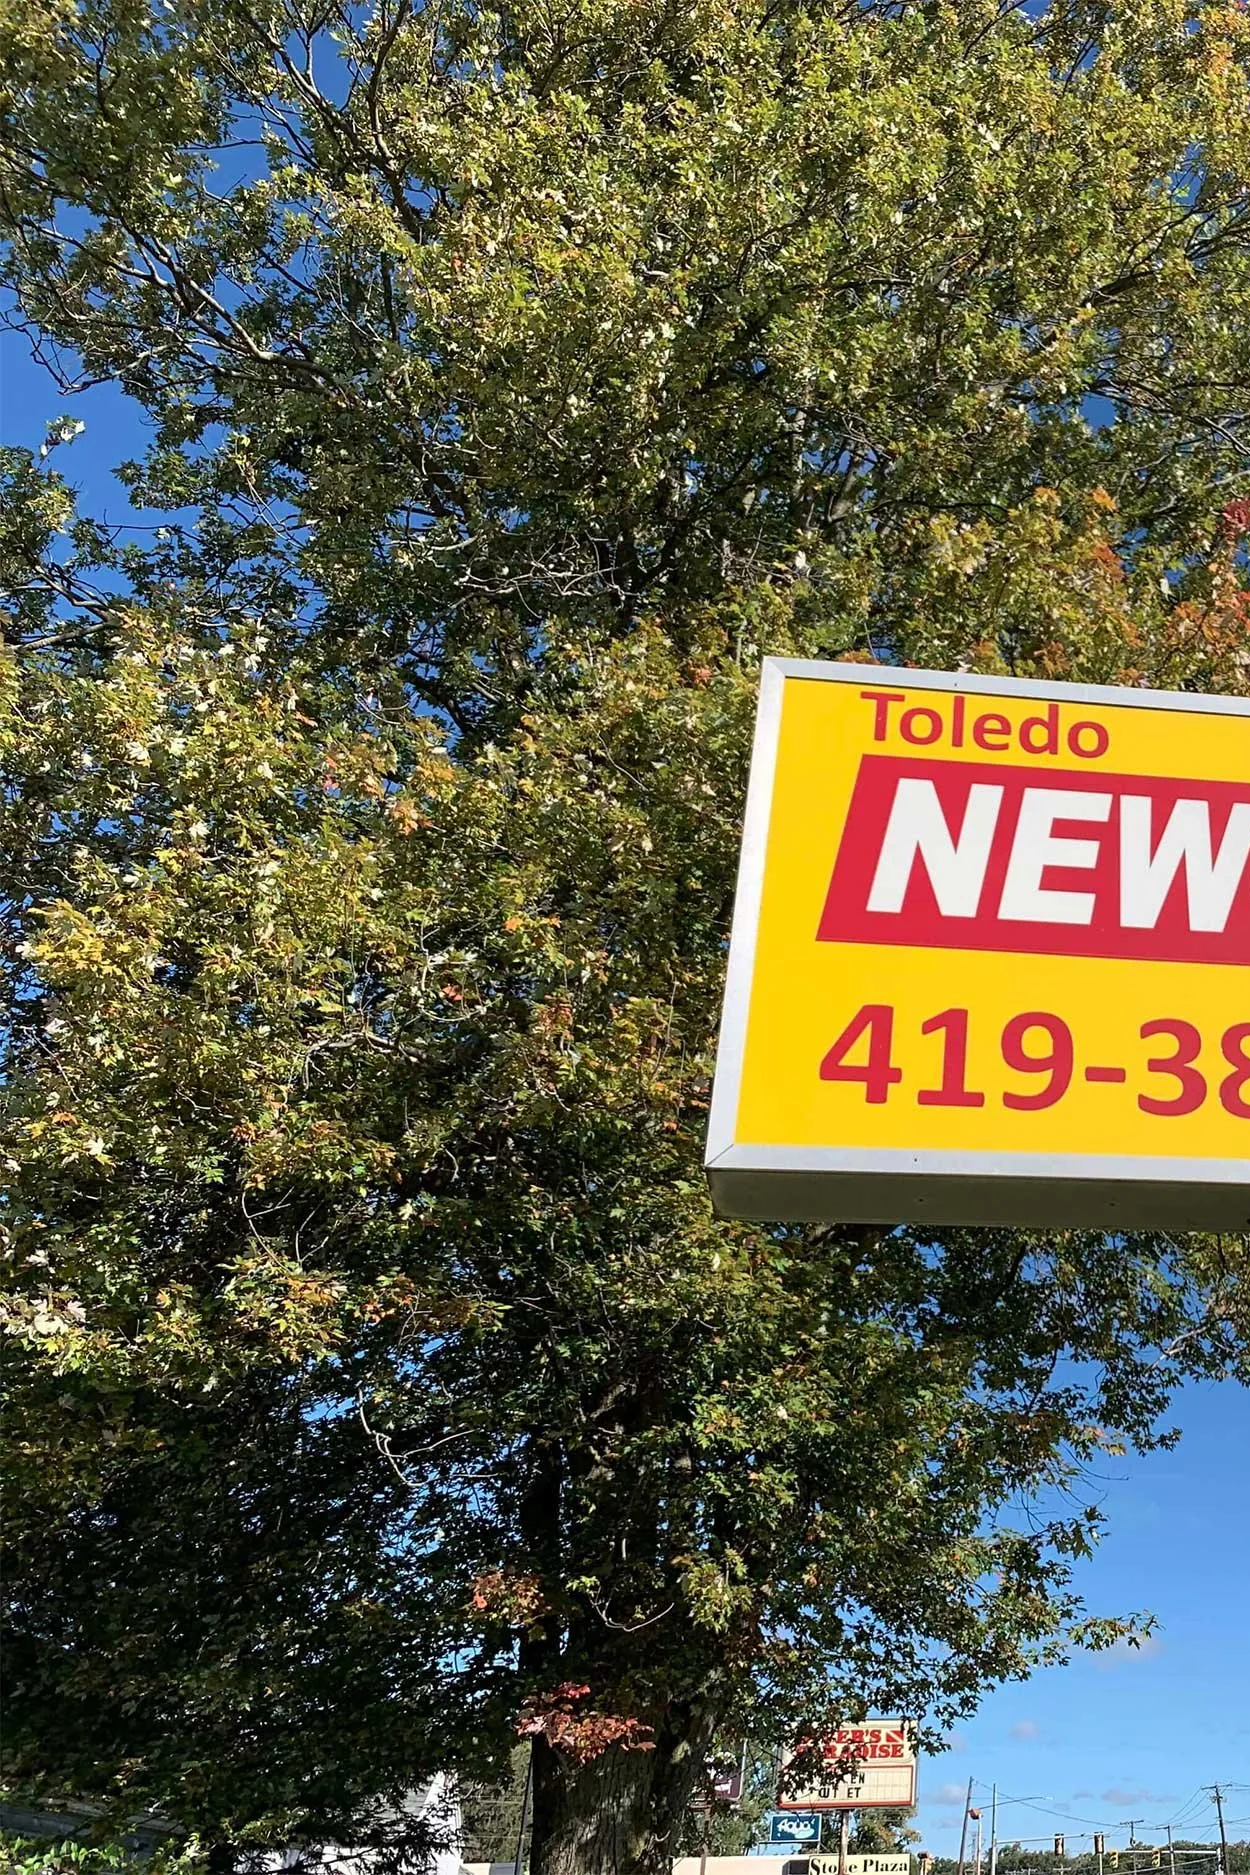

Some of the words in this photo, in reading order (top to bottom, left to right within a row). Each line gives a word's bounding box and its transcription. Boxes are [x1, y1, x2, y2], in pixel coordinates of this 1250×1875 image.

[860, 691, 1109, 758] Toledo
[796, 1744, 904, 1759] RADISE
[810, 1858, 858, 1875] Stoe
[862, 1858, 908, 1873] Plaza
